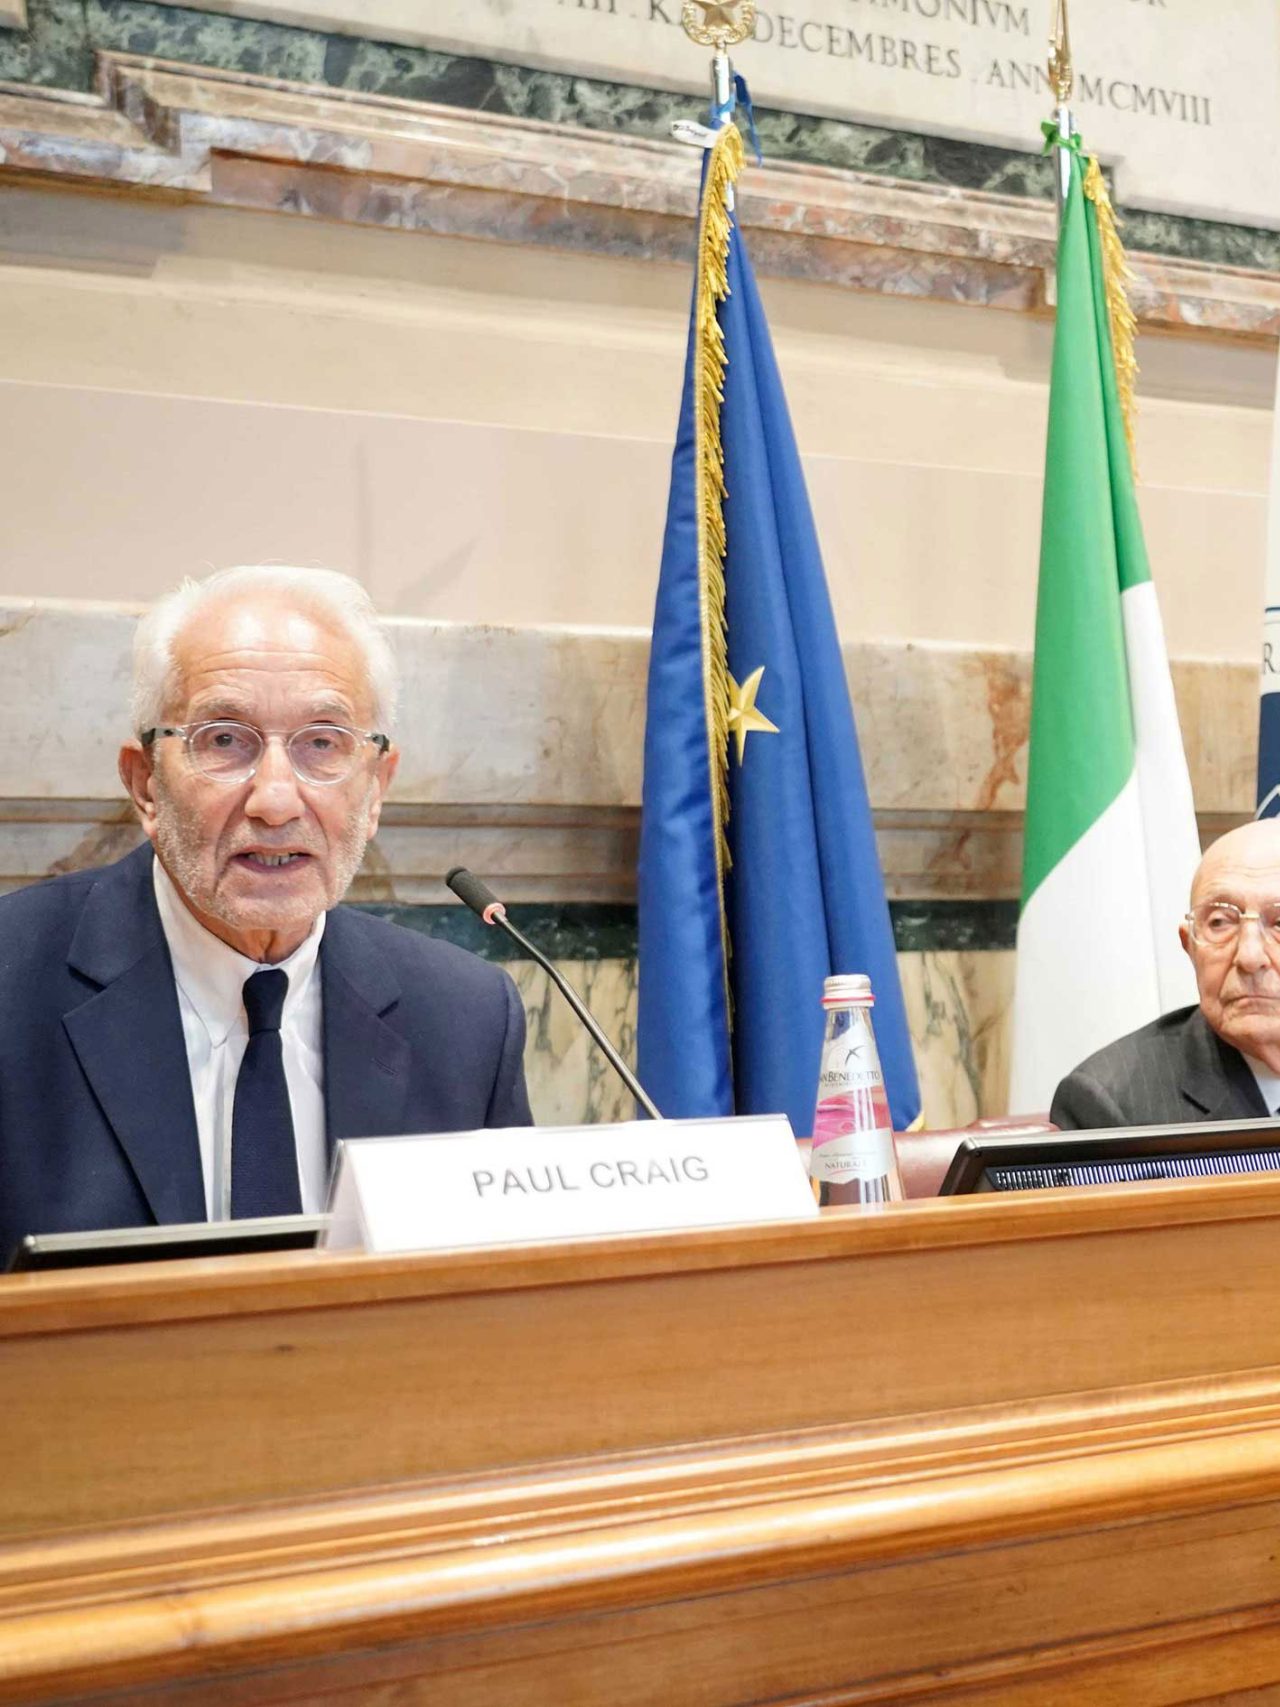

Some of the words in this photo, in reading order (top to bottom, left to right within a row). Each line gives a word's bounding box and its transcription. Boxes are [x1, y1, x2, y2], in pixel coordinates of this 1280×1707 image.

[849, 0, 1030, 36] ONIVM
[750, 10, 962, 79] DECEMBRES
[1079, 74, 1212, 126] MCMVIII
[472, 1164, 581, 1197] PAUL
[589, 1155, 710, 1189] CRAIG
